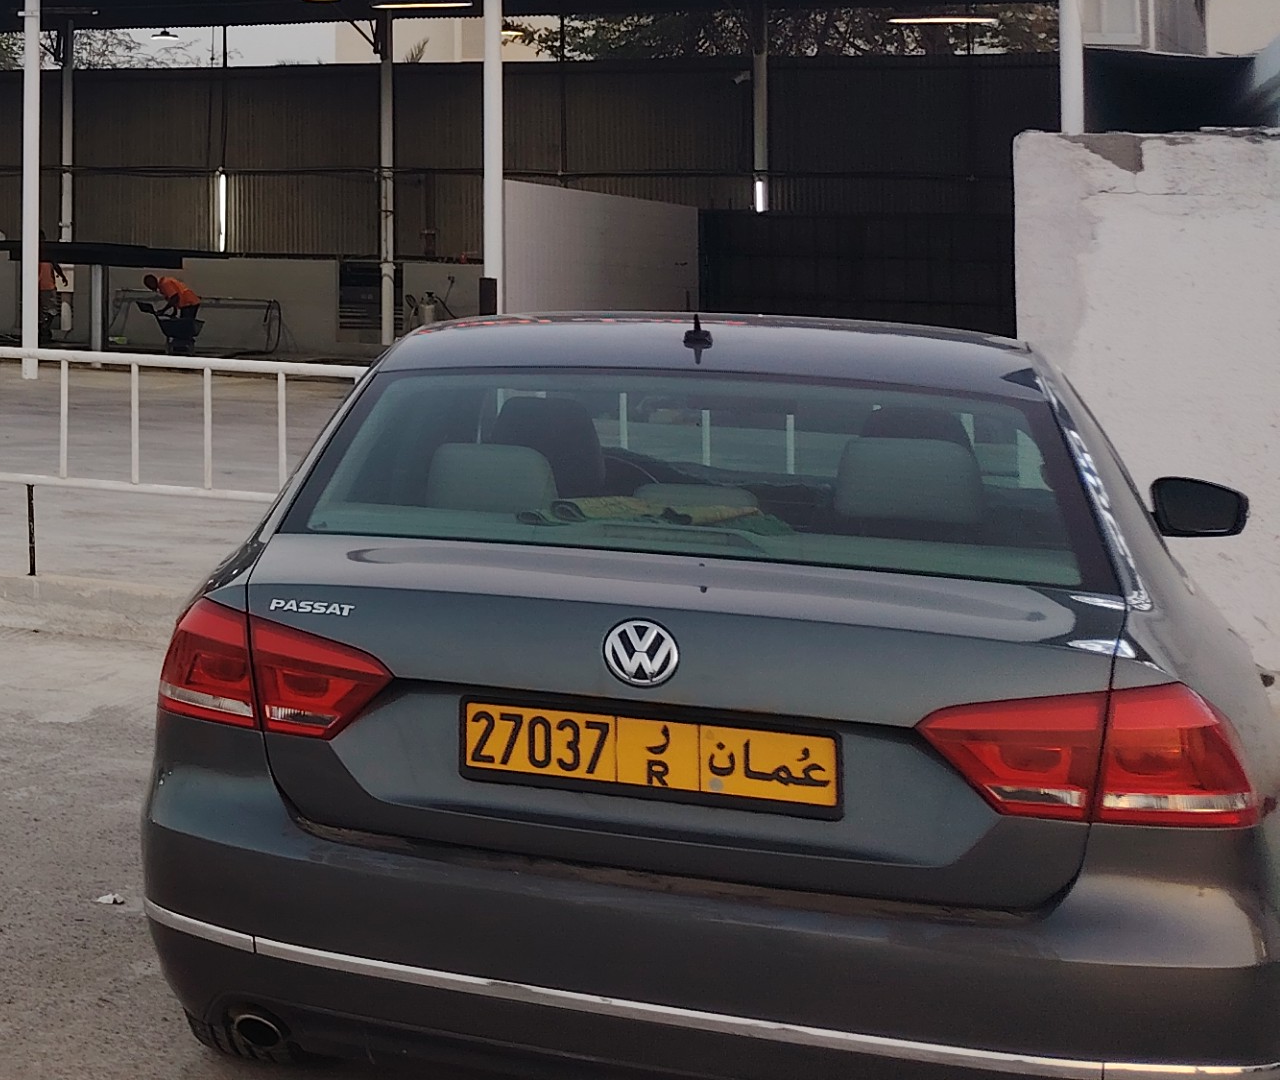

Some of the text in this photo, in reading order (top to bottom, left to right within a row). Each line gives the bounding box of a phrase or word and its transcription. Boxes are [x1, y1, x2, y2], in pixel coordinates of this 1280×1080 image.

[269, 598, 356, 616] PASSAT
[470, 710, 610, 775] 27037
[646, 759, 670, 787] R
